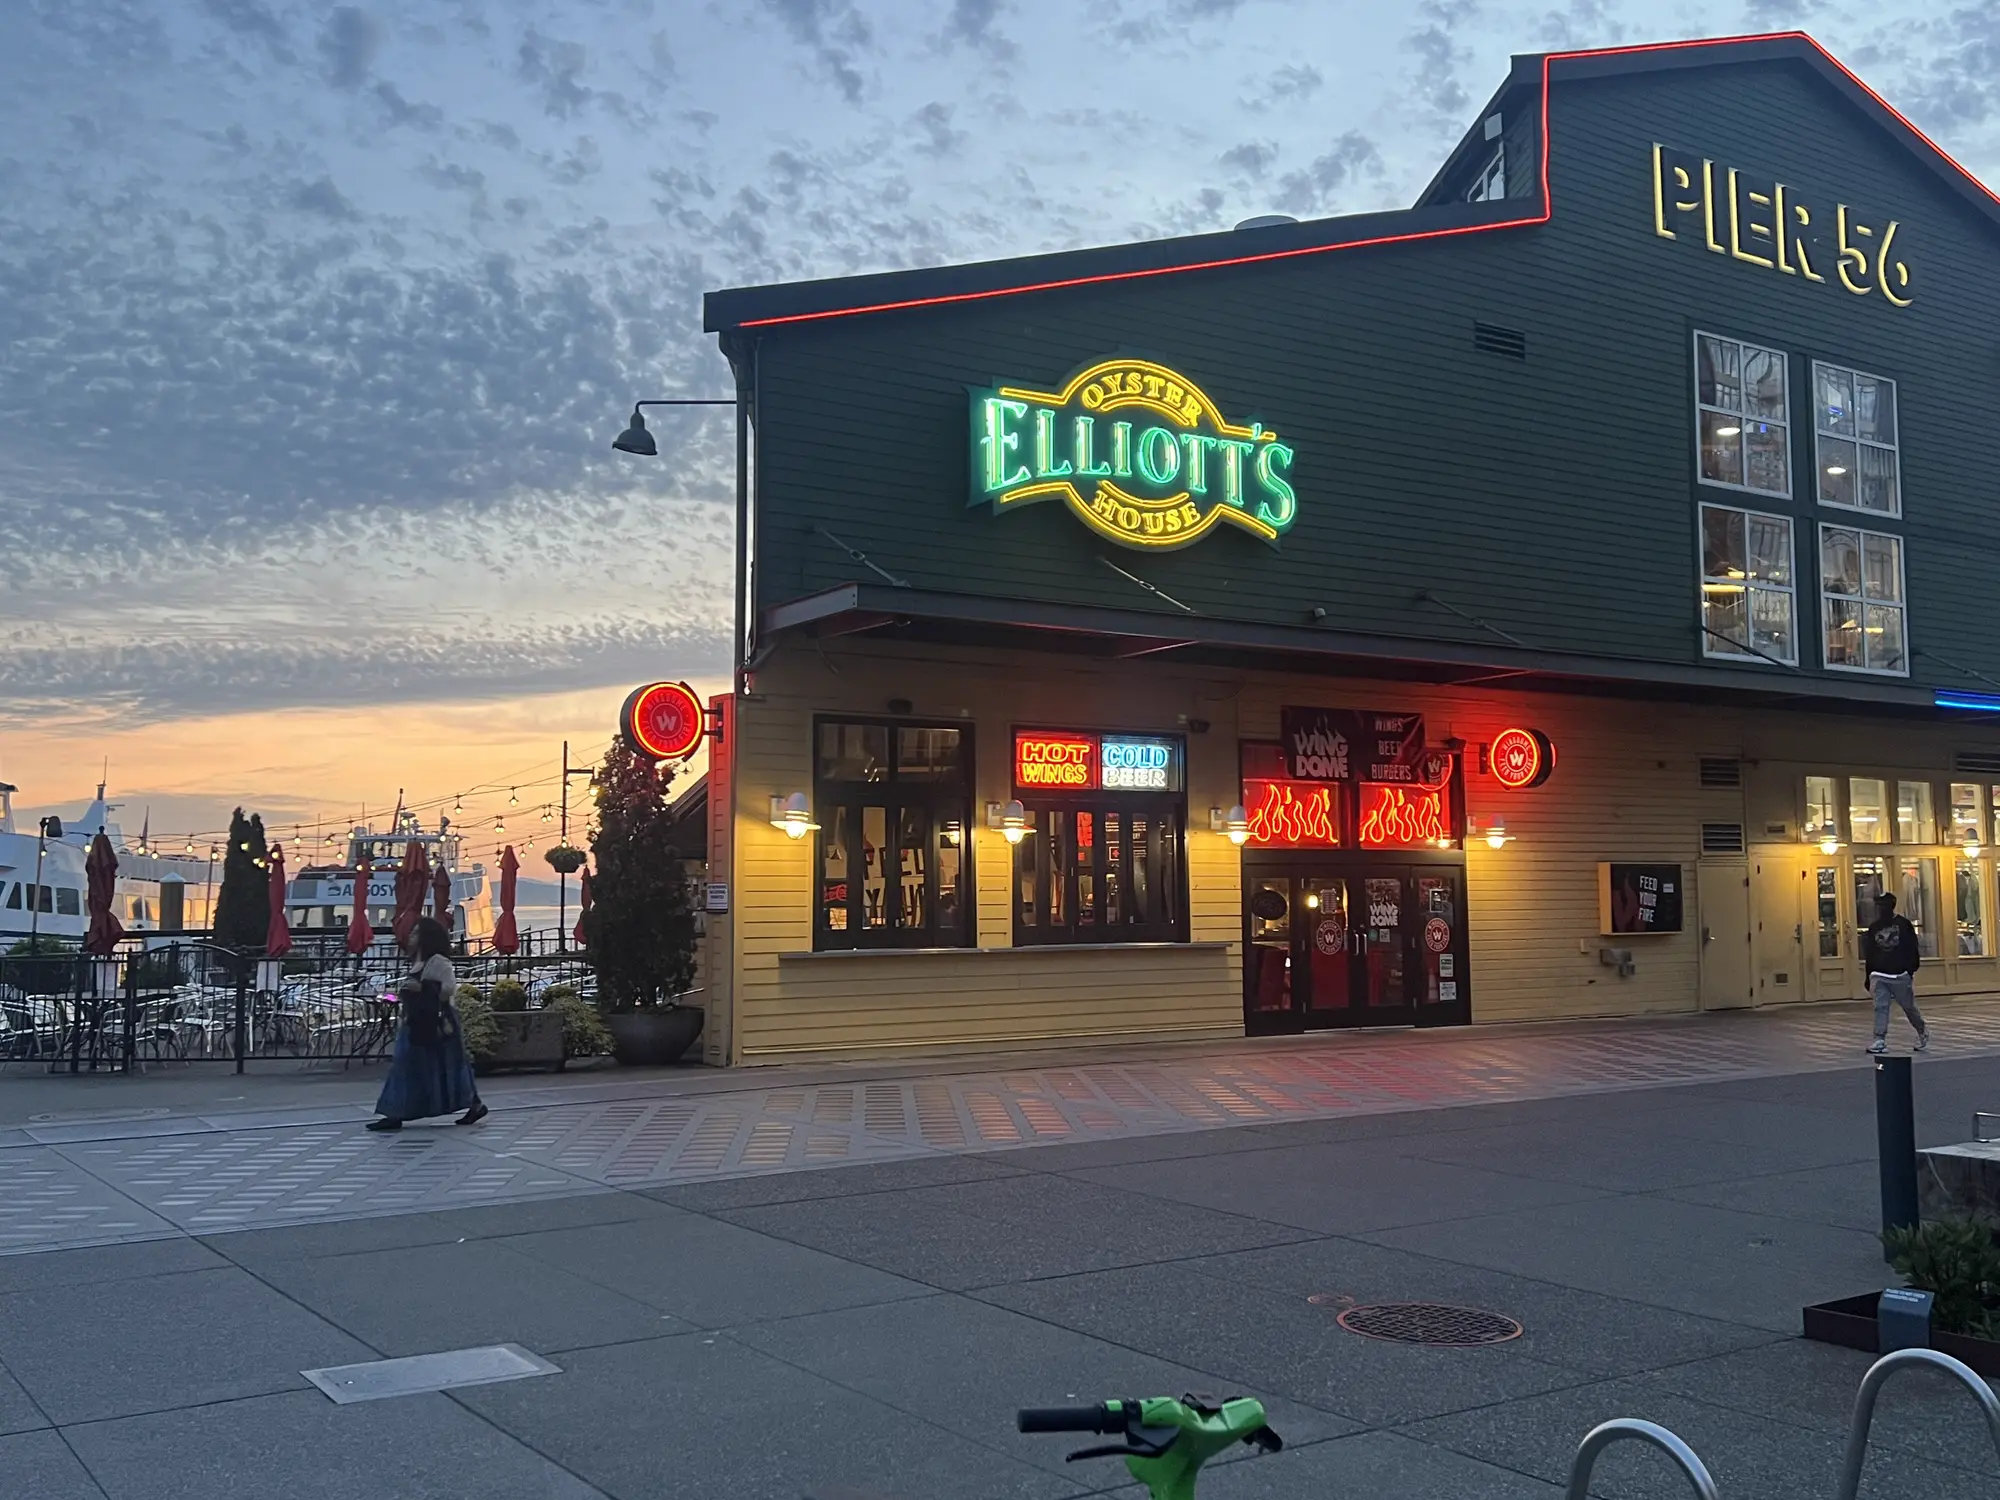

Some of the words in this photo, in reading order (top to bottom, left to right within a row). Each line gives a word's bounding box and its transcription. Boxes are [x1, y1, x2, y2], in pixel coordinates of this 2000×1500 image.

[1652, 142, 1828, 284] PIER
[1837, 203, 1917, 308] 56
[1082, 372, 1203, 427] OYSTER
[980, 397, 1296, 528] ELLIOTT'S
[1092, 490, 1202, 533] HOUSE
[656, 710, 678, 732] W
[1374, 717, 1404, 733] WINGS
[1294, 725, 1348, 757] WING
[1023, 742, 1090, 763] HOT
[1103, 745, 1168, 768] COLD
[1509, 749, 1525, 767] W
[1022, 763, 1088, 784] WINGS
[1296, 755, 1348, 778] DOME
[1371, 763, 1412, 780] BURGERS
[1102, 768, 1167, 788] BEER
[343, 884, 396, 897] AOSY
[1640, 875, 1658, 891] FEED
[1369, 900, 1398, 916] WING
[1639, 892, 1657, 907] YOUR
[1370, 915, 1398, 926] DOME
[1639, 907, 1655, 923] FIRE
[1324, 932, 1335, 944] W
[1433, 928, 1442, 941] W
